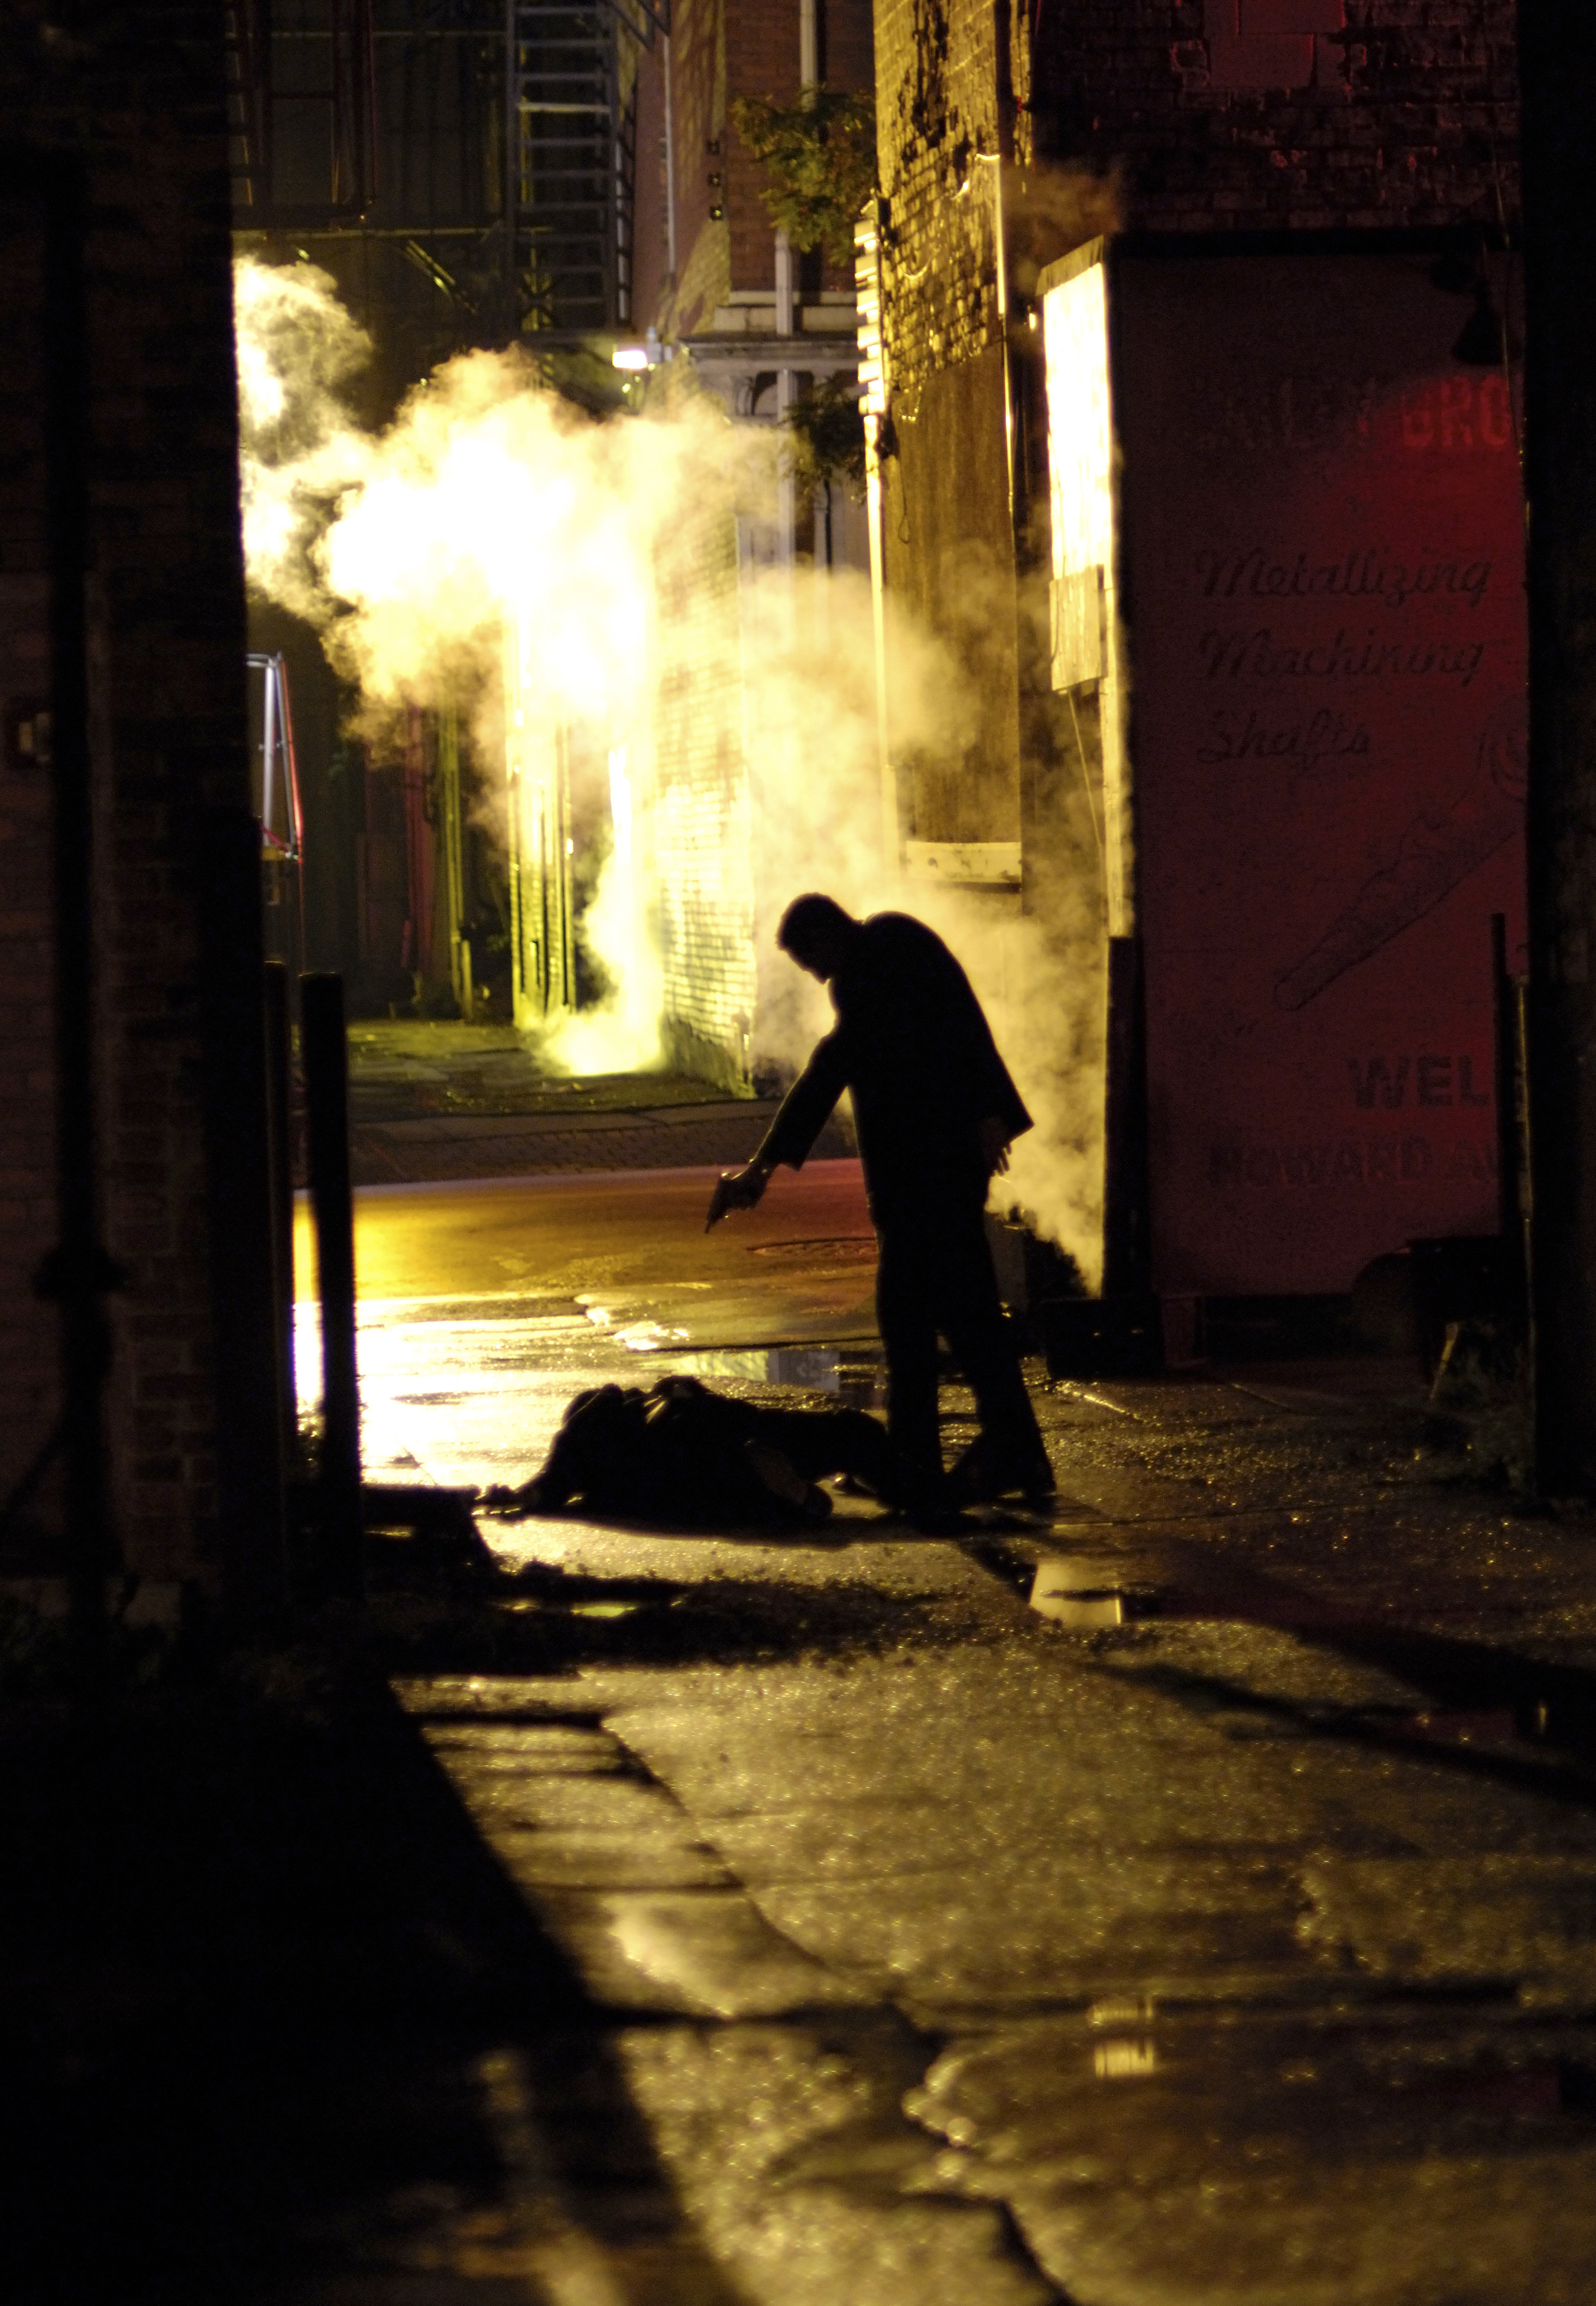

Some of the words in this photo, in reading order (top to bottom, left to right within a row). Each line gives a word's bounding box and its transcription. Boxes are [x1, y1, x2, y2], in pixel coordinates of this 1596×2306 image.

[1195, 546, 1492, 608] Metallizing
[1197, 627, 1485, 688] Machining
[1195, 707, 1370, 771] Shafts
